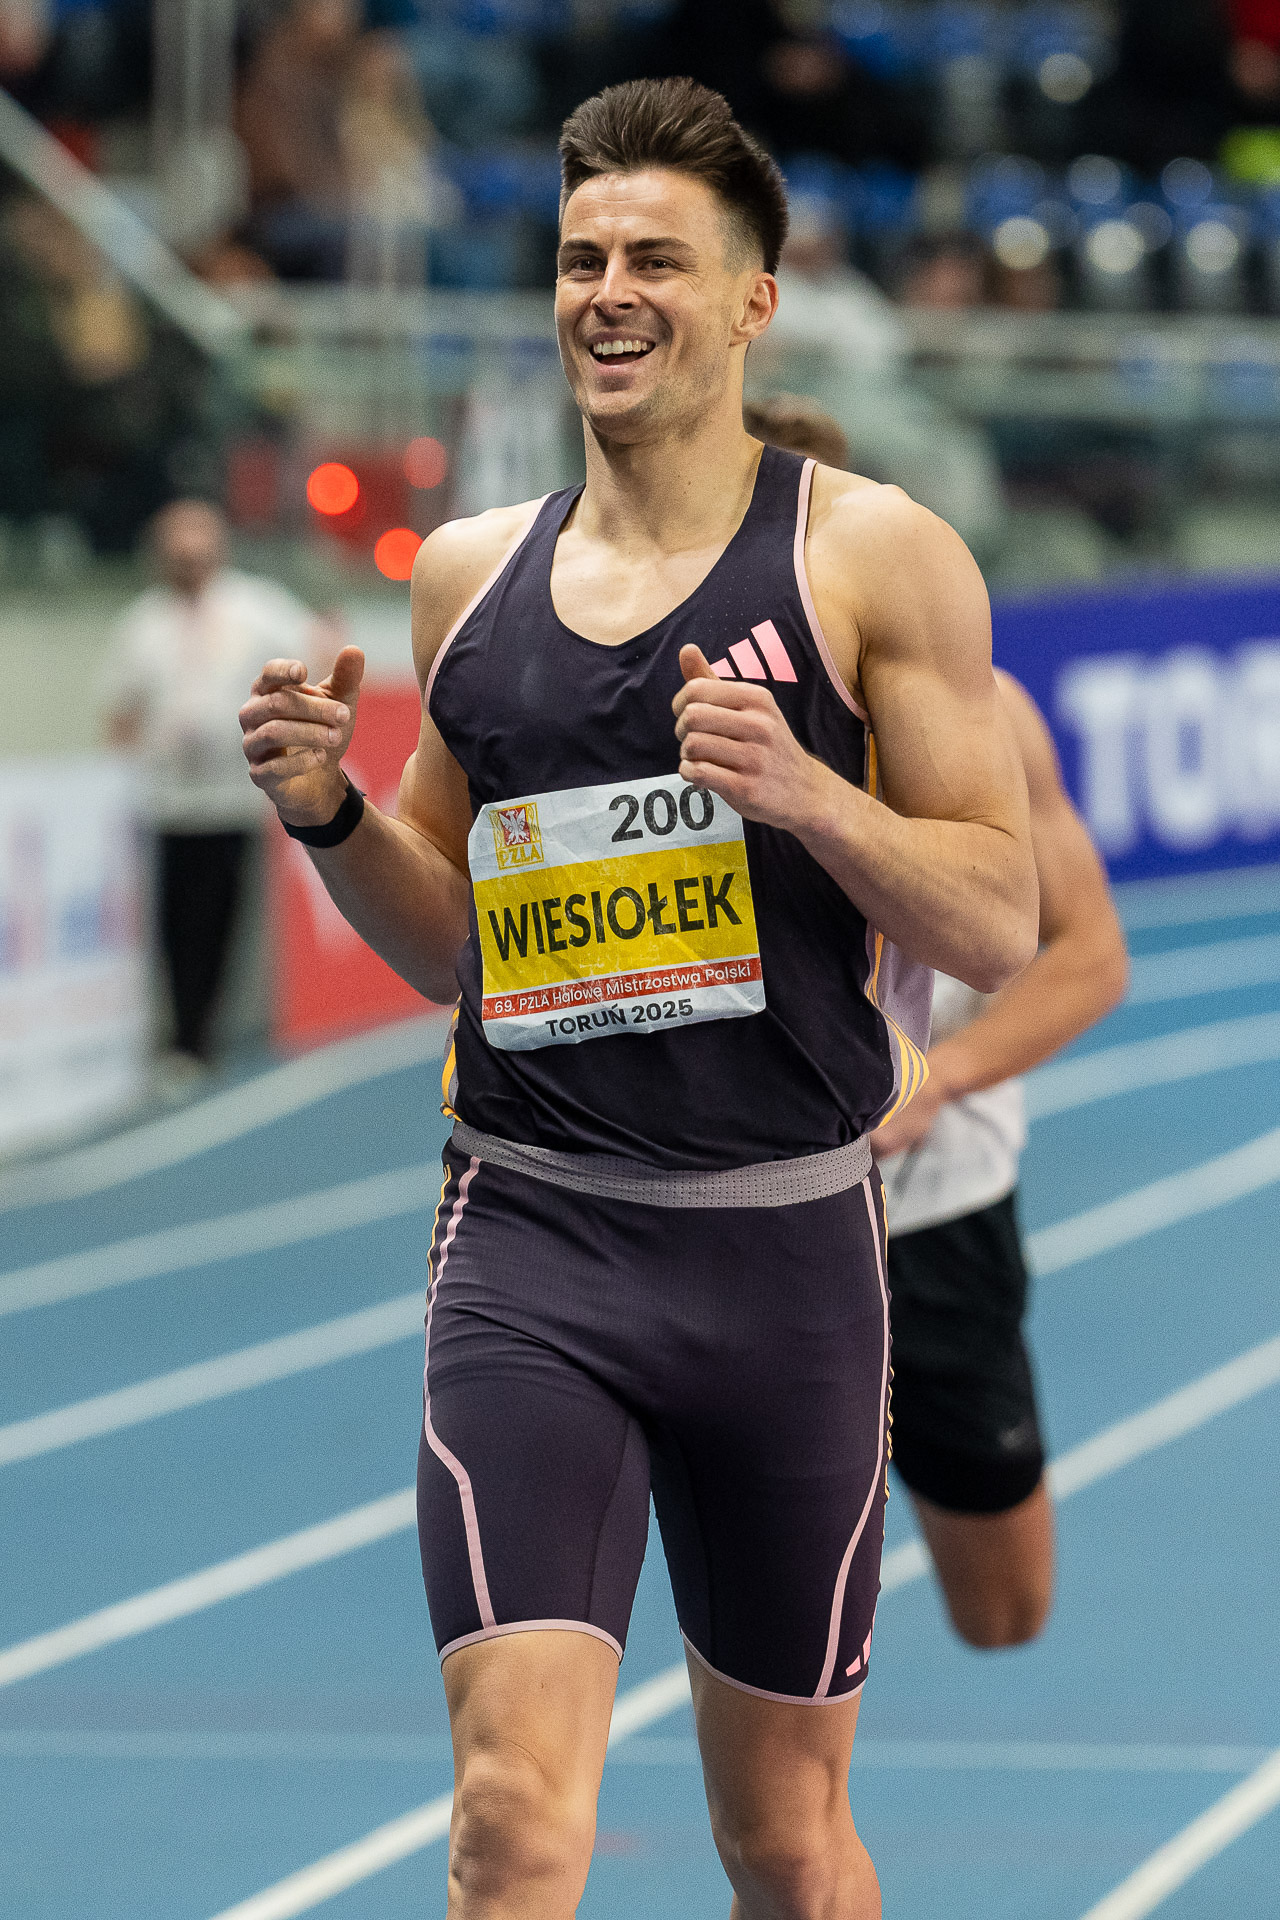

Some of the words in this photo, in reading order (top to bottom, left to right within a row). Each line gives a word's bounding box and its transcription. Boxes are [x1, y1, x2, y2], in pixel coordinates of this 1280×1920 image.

[608, 784, 715, 842] 200
[499, 847, 542, 867] PZLA
[488, 872, 742, 962] WIESIOŁEK
[494, 1000, 516, 1014] 69.
[519, 995, 550, 1010] PZLA
[552, 986, 602, 1006] Halowe
[606, 971, 701, 996] Mistrzostwa
[705, 963, 751, 981] Polski
[545, 1004, 626, 1037] TORUŃ
[631, 998, 694, 1024] 2025
